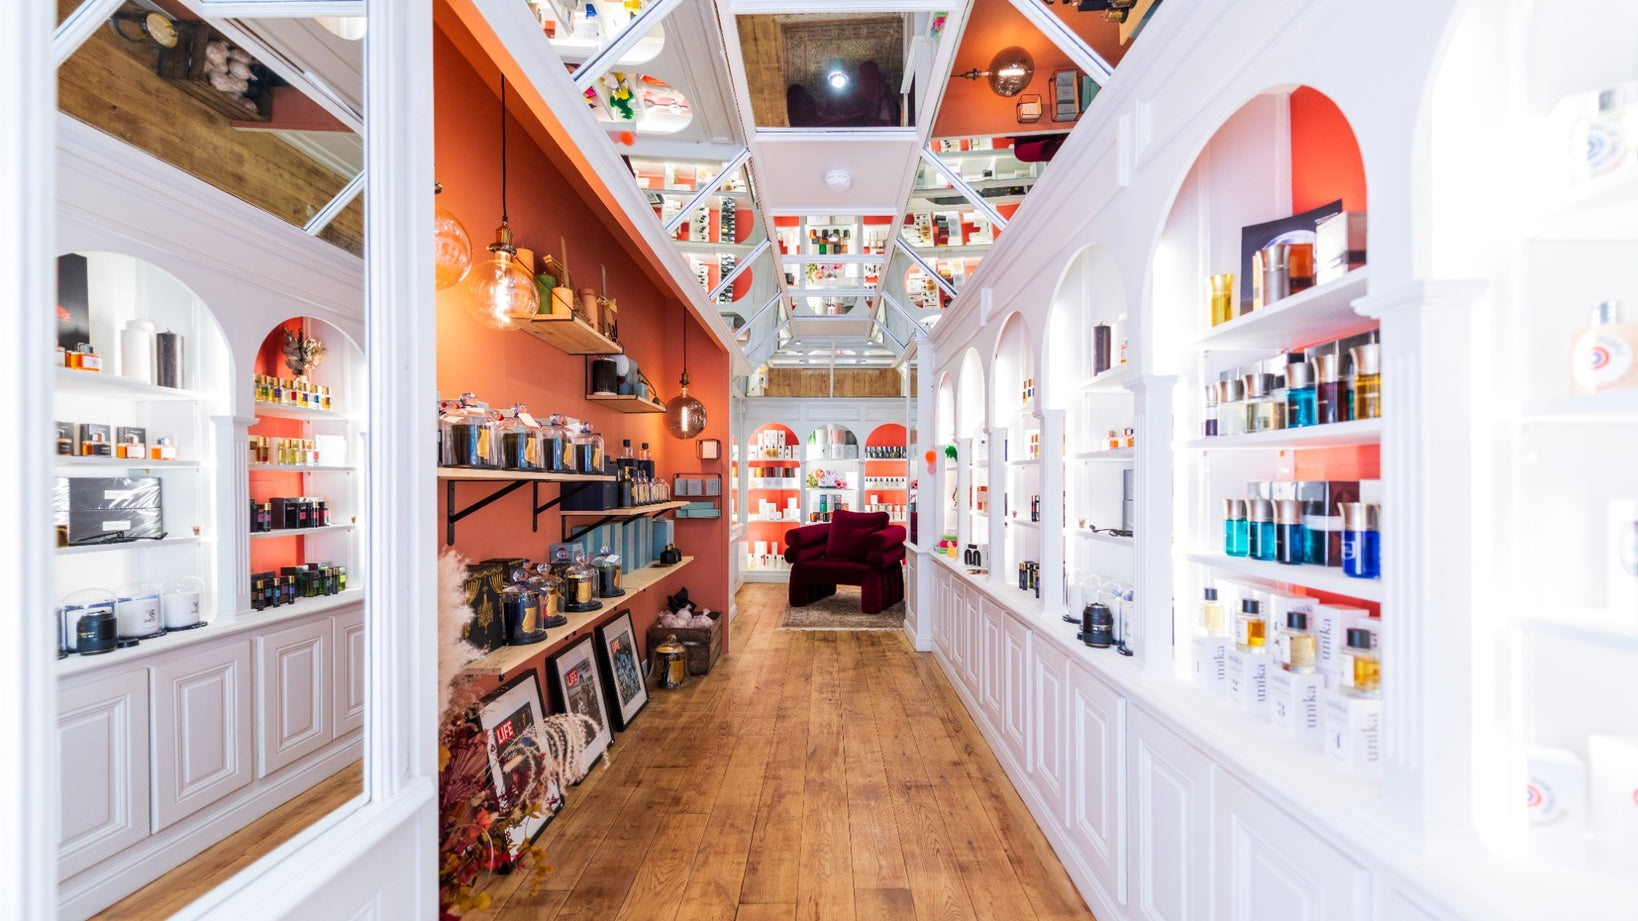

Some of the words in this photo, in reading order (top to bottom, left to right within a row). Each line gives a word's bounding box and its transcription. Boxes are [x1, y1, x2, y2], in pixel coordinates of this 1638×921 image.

[1319, 618, 1332, 661] unika
[566, 671, 578, 686] LIFE
[1213, 645, 1225, 681] unika
[1253, 664, 1266, 702] unika
[1302, 685, 1317, 729] unika
[496, 721, 514, 743] LIFE
[1362, 712, 1379, 762] unika
